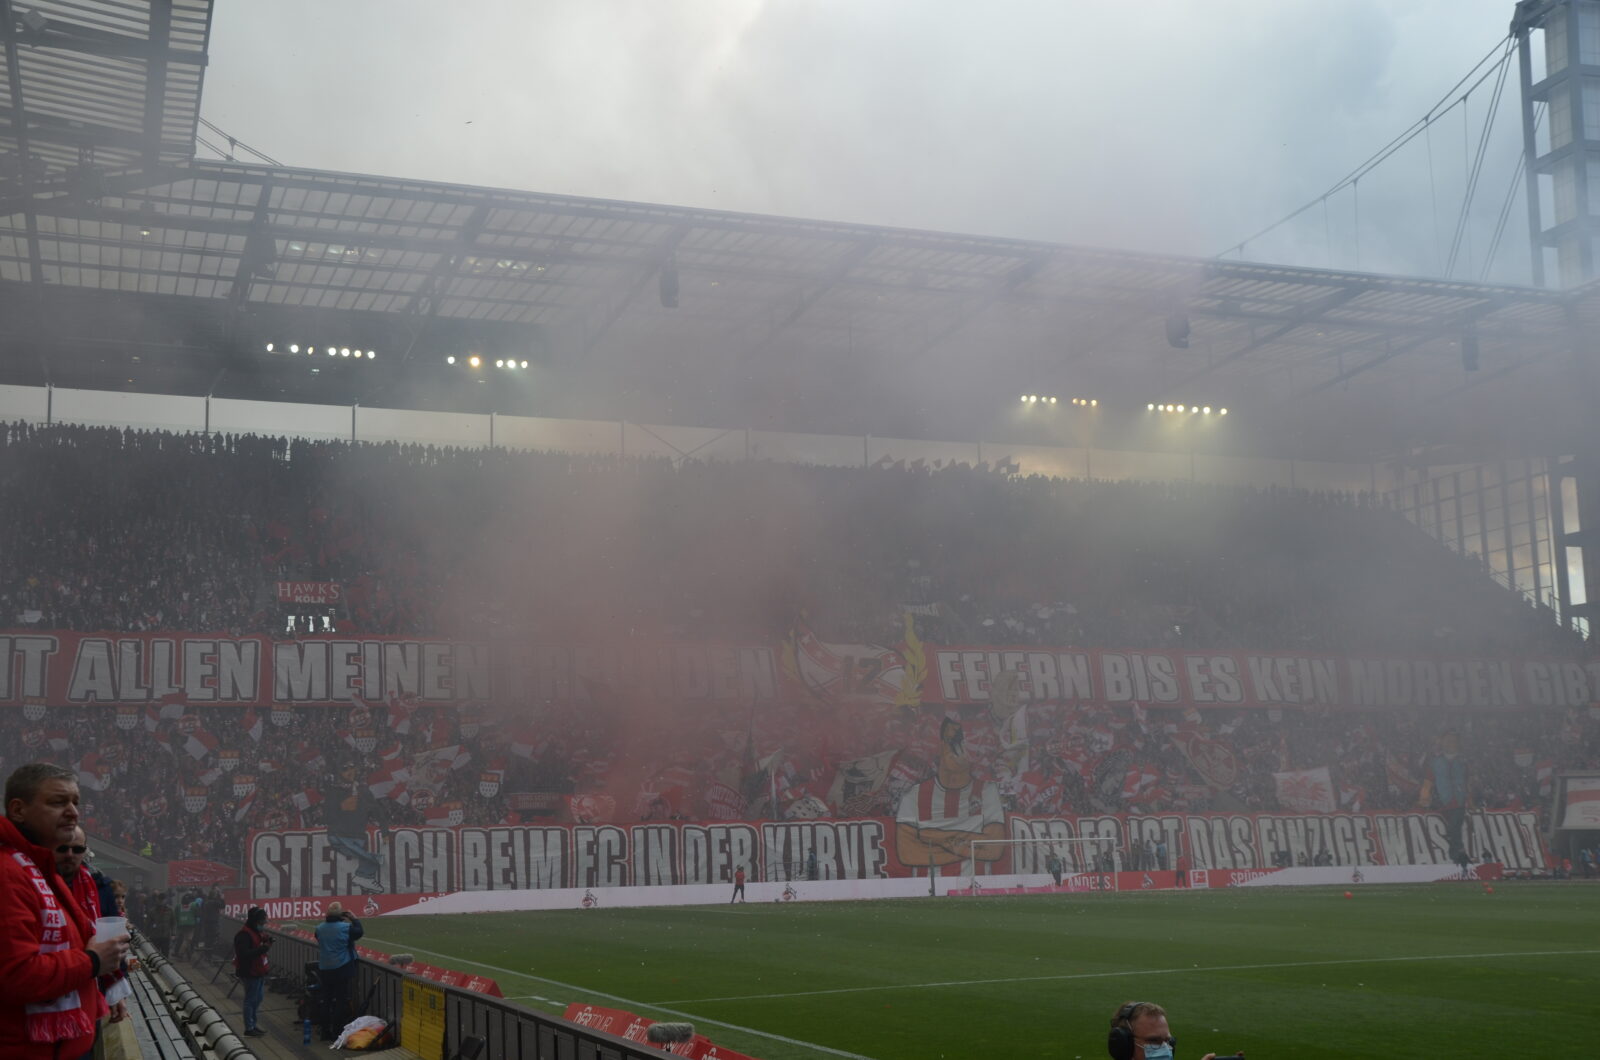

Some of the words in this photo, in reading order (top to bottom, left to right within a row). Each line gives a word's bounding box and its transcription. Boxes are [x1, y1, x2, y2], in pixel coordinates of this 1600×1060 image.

[277, 582, 341, 600] HAWKS
[295, 594, 326, 604] KÖLN
[68, 638, 260, 702] ALLEN
[272, 640, 492, 702] MEINEN
[936, 650, 1093, 701] FEIERN
[1102, 651, 1180, 704] BIS
[1184, 655, 1246, 703] ES
[1248, 655, 1340, 704] KEIN
[1348, 657, 1517, 706] MORGEN
[457, 825, 570, 891] BEIM
[573, 825, 628, 889] FC
[631, 823, 678, 887] IN
[681, 823, 760, 885] DER
[762, 821, 888, 883] KURVE
[1011, 816, 1076, 875] DER
[1186, 815, 1254, 871] DAS
[1257, 814, 1379, 869] EINZIGE
[1375, 813, 1456, 866] WAS
[263, 901, 326, 919] ANDERS.
